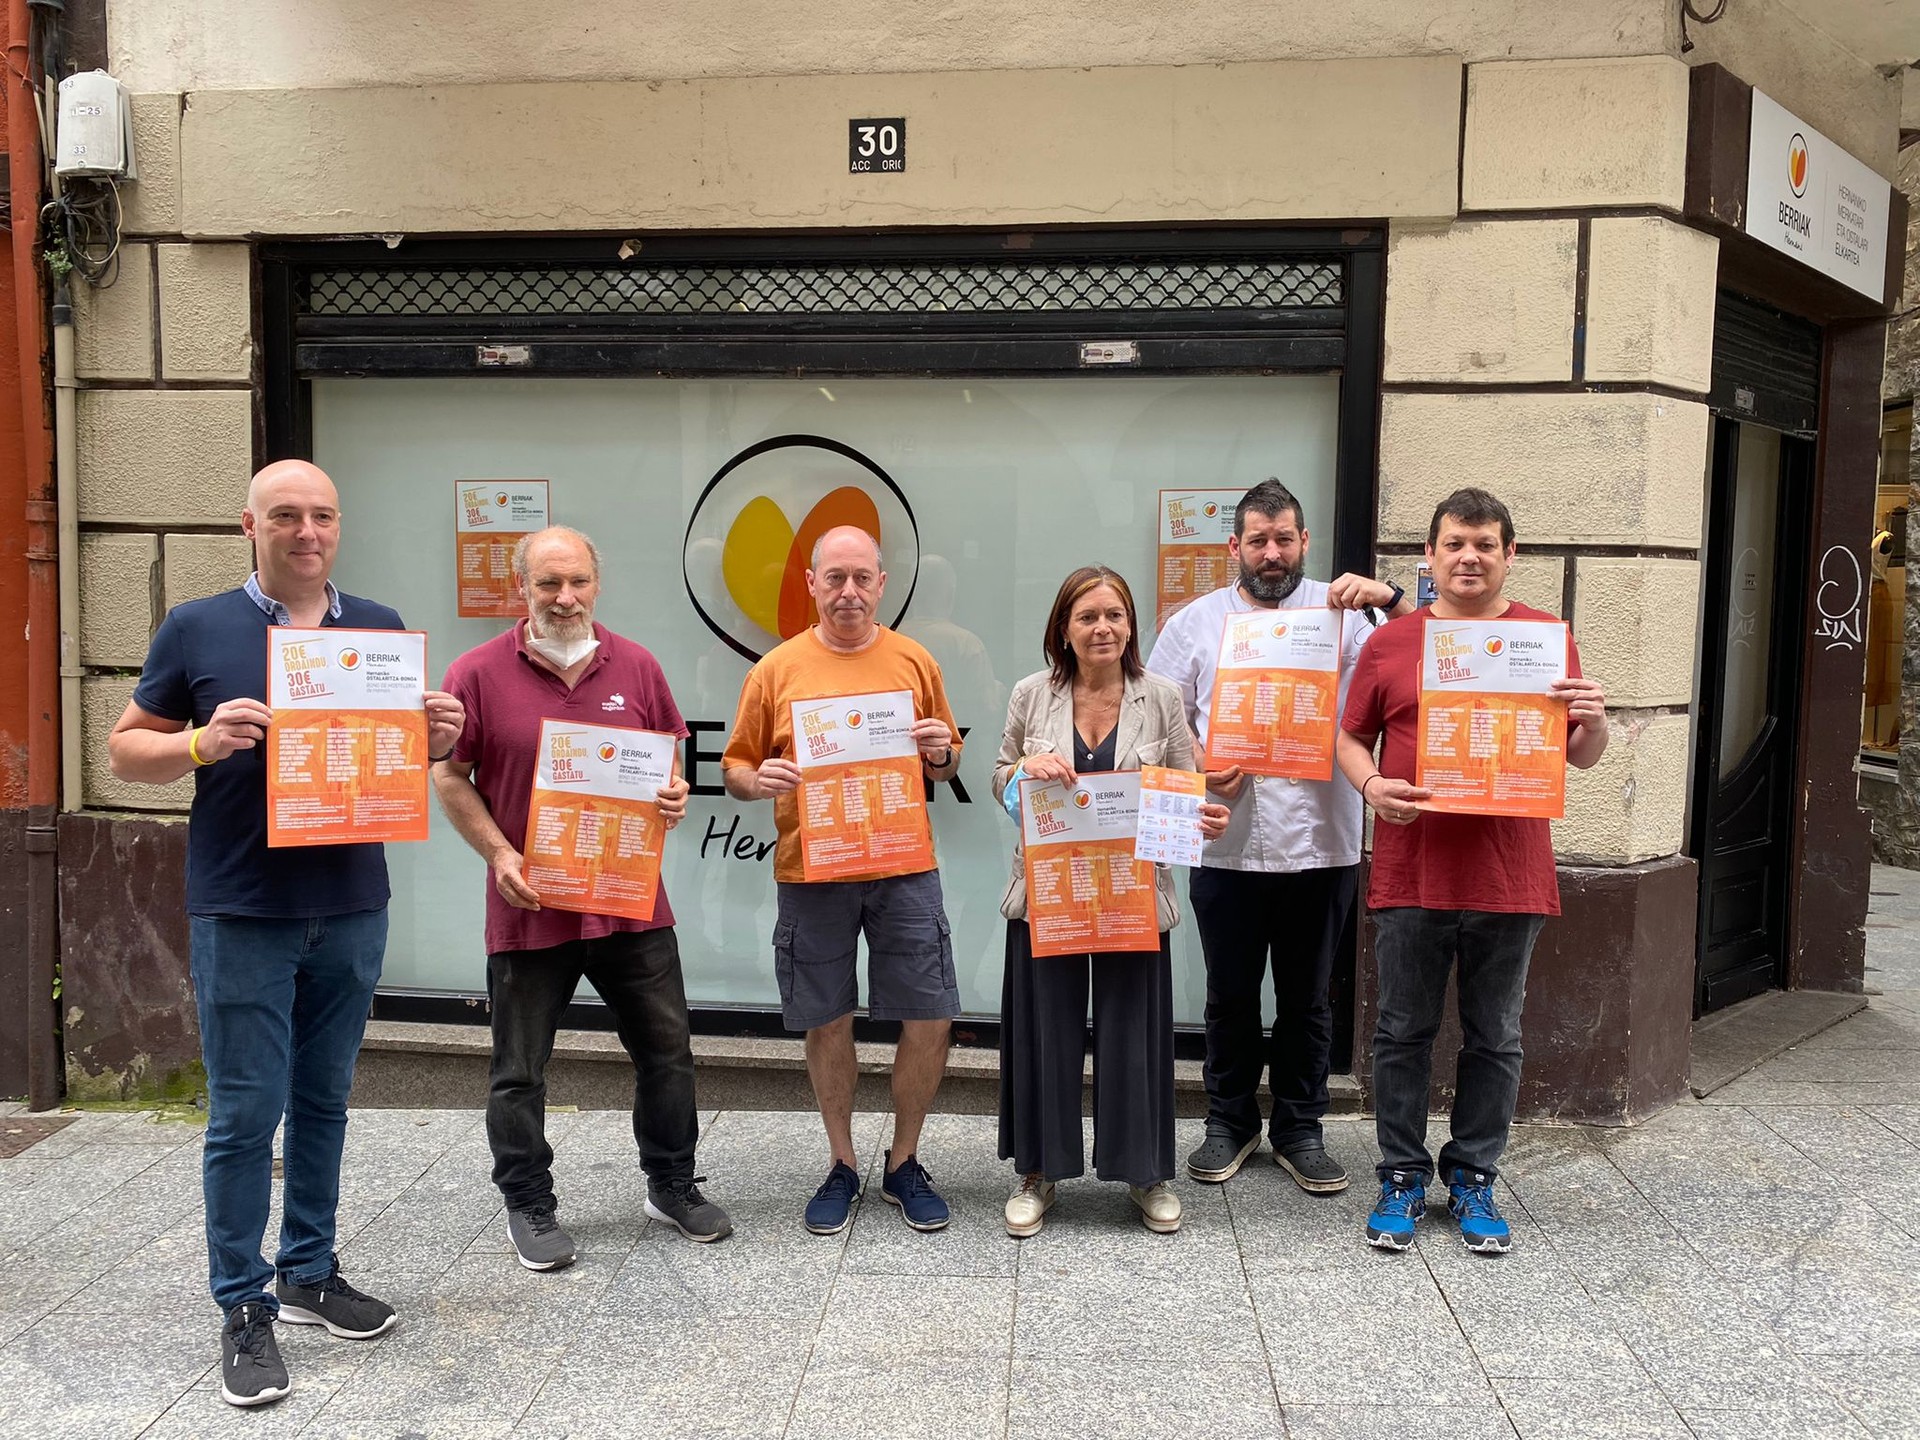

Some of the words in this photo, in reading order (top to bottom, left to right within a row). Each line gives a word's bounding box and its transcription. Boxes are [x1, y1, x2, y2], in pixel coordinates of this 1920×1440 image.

[858, 126, 897, 157] 30
[74, 146, 86, 154] 33
[852, 160, 870, 170] ACC
[1778, 201, 1811, 238] BERRIAK
[1836, 222, 1846, 239] ETA
[1846, 228, 1868, 252] OSTALARI
[1835, 242, 1860, 266] ELKARTEA
[466, 508, 480, 518] 30€
[1168, 502, 1183, 512] 20€
[1170, 519, 1185, 530] 30€
[1233, 640, 1250, 652] 30€
[1434, 634, 1455, 648] 20€
[1510, 641, 1543, 649] BERRIAK
[282, 645, 307, 661] 20€
[366, 653, 401, 663] BERRIAK
[1437, 657, 1458, 670] 30€
[287, 670, 311, 687] 30€
[1439, 668, 1471, 680] GASTATU
[289, 683, 326, 697] GASTATU
[802, 712, 821, 727] 20€
[867, 710, 896, 720] BERRIAK
[551, 736, 571, 749] 20€
[807, 733, 826, 748] 30€
[621, 749, 652, 760] BERRIAK
[810, 742, 838, 757] GASTATU
[552, 758, 573, 771] 30€
[552, 770, 583, 780] GASTATU
[1030, 791, 1047, 806] 20€
[1096, 790, 1125, 800] BERRIAK
[1035, 812, 1054, 826] 30€
[1038, 820, 1066, 834] GASTATU
[1159, 834, 1166, 842] 5€
[1192, 838, 1199, 846] 5€
[1157, 850, 1165, 858] 5€
[1190, 854, 1198, 862] 5€
